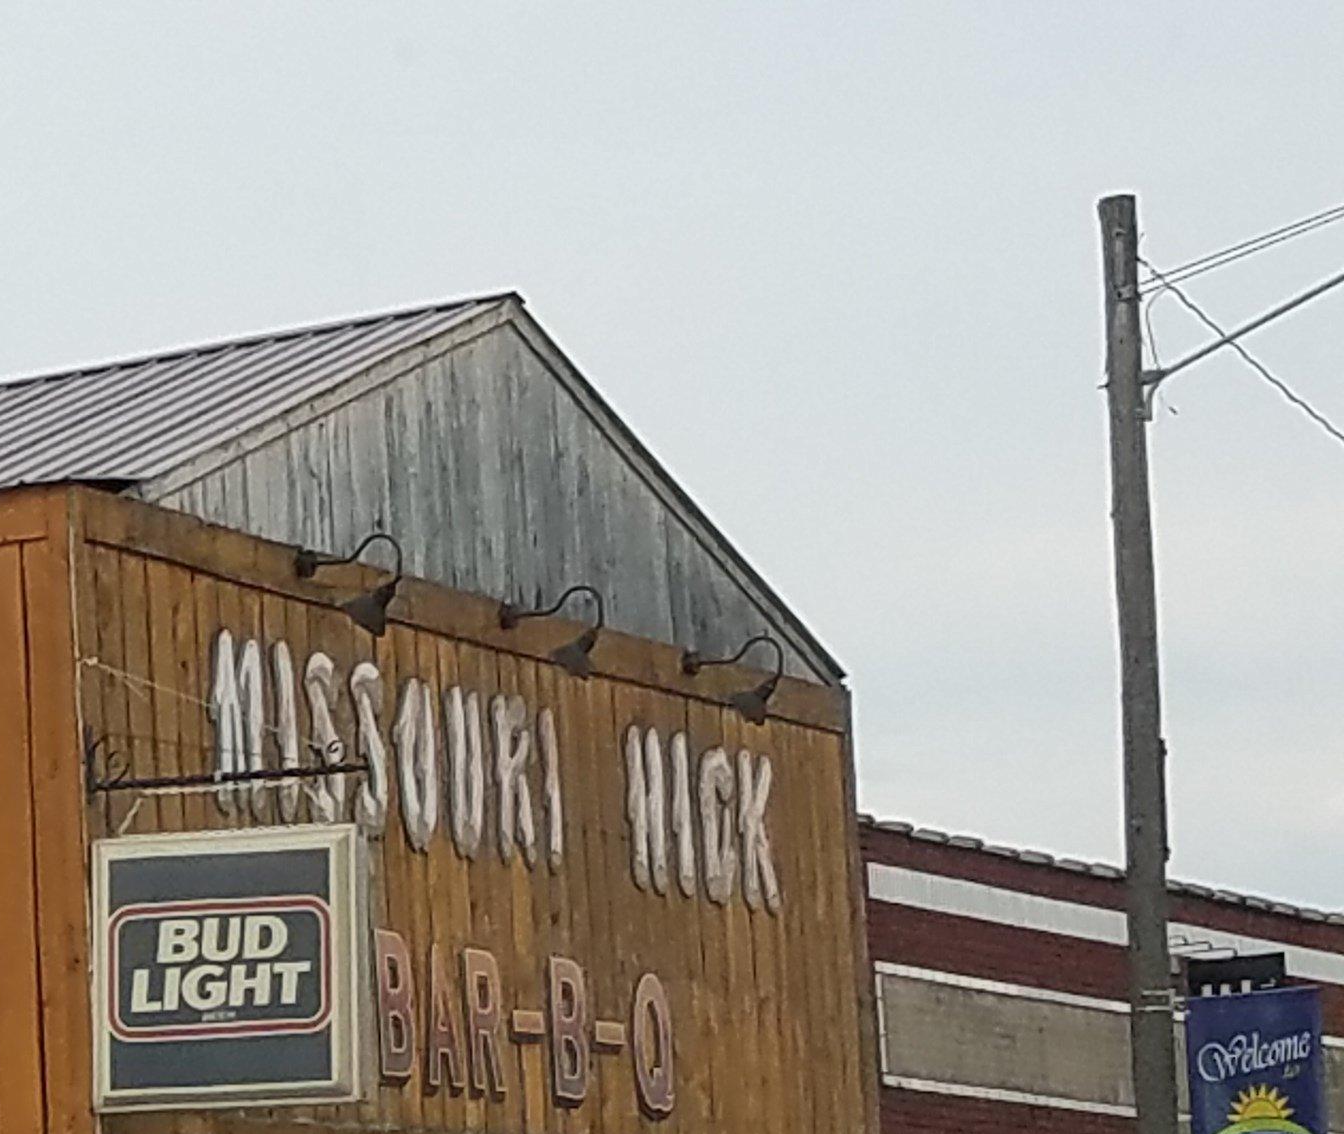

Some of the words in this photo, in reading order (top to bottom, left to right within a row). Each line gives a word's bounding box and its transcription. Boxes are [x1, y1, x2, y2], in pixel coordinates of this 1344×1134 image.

[215, 628, 563, 874] MISSOURI
[622, 724, 782, 915] HICK
[157, 915, 288, 964] BUD
[130, 960, 311, 1013] LIGHT
[374, 927, 676, 1121] BAR-B-Q
[1197, 1031, 1311, 1081] Welcome
